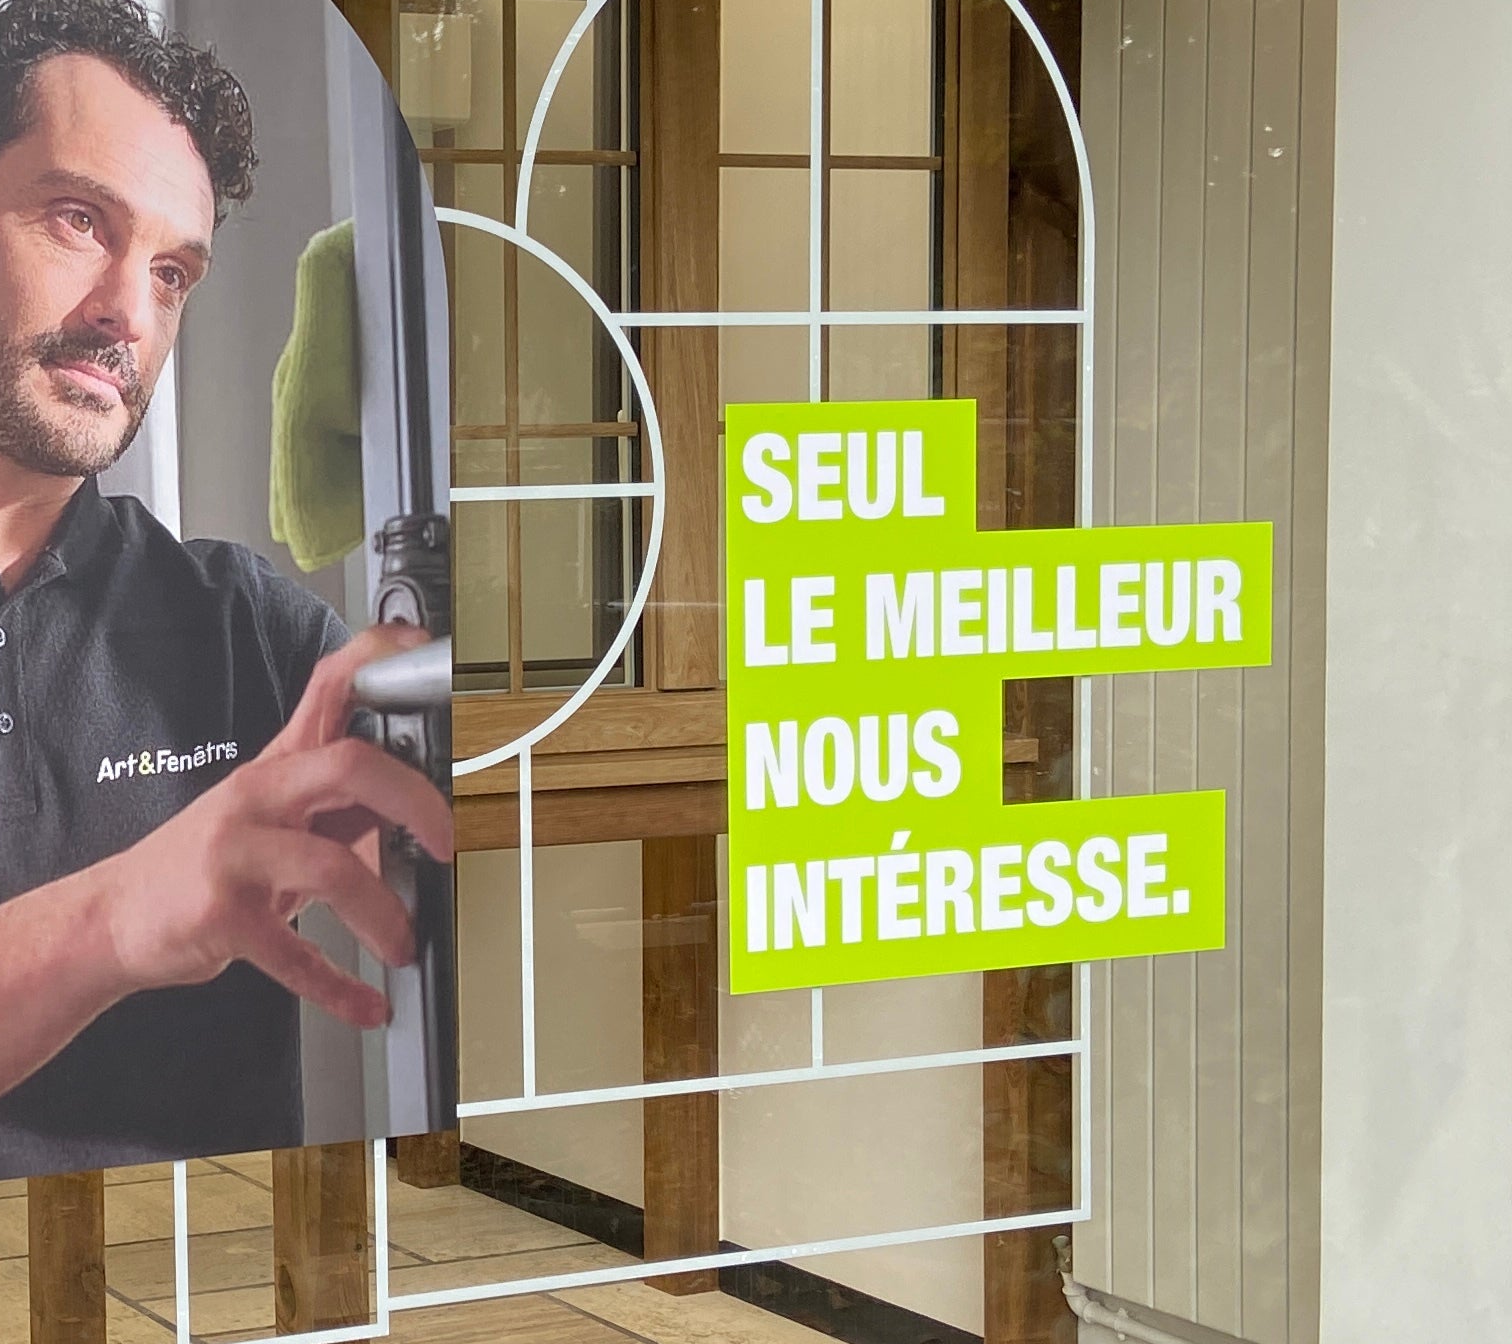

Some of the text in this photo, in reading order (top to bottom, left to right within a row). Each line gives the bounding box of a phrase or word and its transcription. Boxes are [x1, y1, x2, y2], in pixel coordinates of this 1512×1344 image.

[740, 429, 946, 525] SEUL
[743, 558, 1244, 668] LE MEILLEUR
[744, 708, 963, 811] NOUS
[745, 829, 1191, 954] INTÉRESSE.
